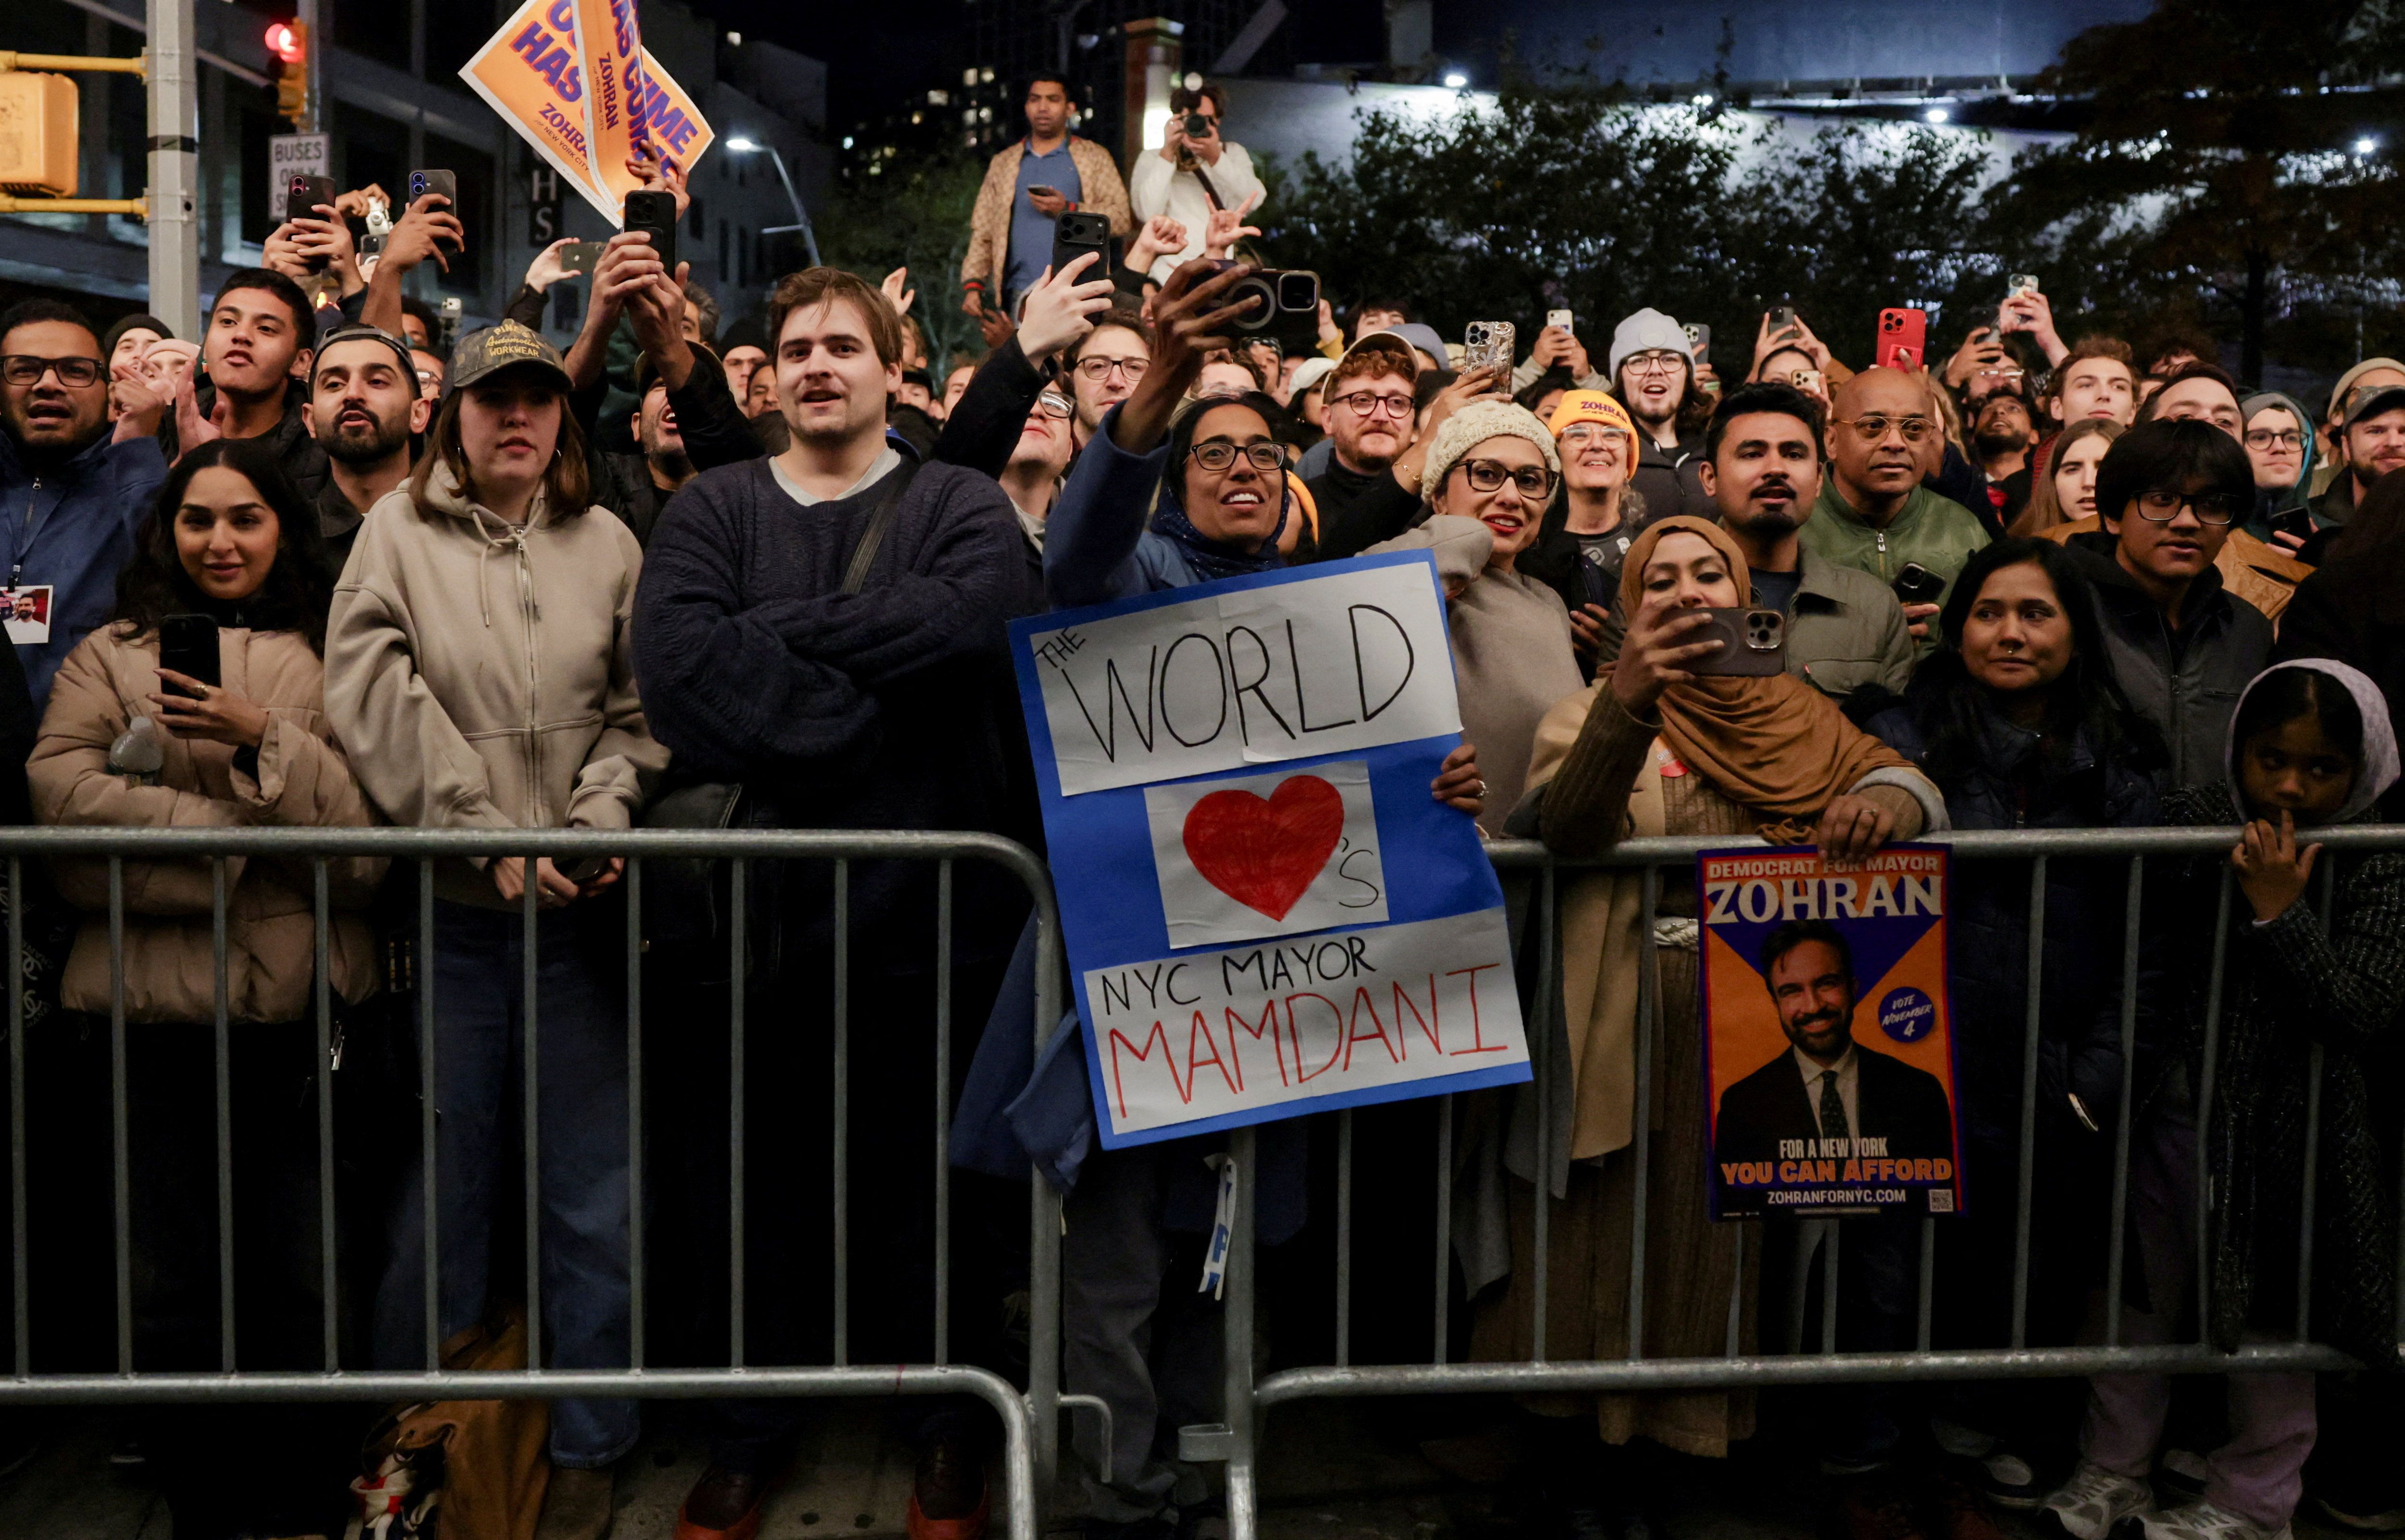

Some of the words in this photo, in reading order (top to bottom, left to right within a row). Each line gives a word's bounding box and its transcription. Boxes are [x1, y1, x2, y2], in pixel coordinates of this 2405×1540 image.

[609, 0, 635, 58] AS
[508, 21, 582, 102] HAS
[598, 51, 619, 130] ZOHRAN
[643, 70, 698, 156] IME
[275, 141, 323, 162] BUSES
[544, 126, 559, 141] NEW
[559, 141, 576, 158] YORK
[575, 157, 590, 171] CITY
[489, 346, 539, 357] WORKWEAR
[1034, 627, 1086, 669] THE
[1061, 603, 1415, 764] WORLD
[1709, 860, 1816, 879] DEMOCRAT
[1823, 859, 1861, 873] FOR
[1866, 856, 1938, 872] MAYOR
[1705, 874, 1943, 925] ZOHRAN
[1101, 963, 1201, 1015] NYC
[1222, 936, 1377, 997] MAYOR
[1882, 1004, 1933, 1027] NOVEMBER
[1892, 994, 1915, 1010] VOTE
[1106, 963, 1508, 1118] MAMDANI
[1903, 1020, 1916, 1037] 4
[1780, 1139, 1804, 1159] FOR
[1807, 1139, 1817, 1158] A
[1820, 1138, 1850, 1158] NEW
[1851, 1136, 1888, 1158] YORK
[1721, 1162, 1773, 1185] YOU
[1779, 1160, 1836, 1183] CAN
[1843, 1158, 1952, 1181] AFFORD
[1767, 1188, 1906, 1205] ZOHRANFORNYC.COM
